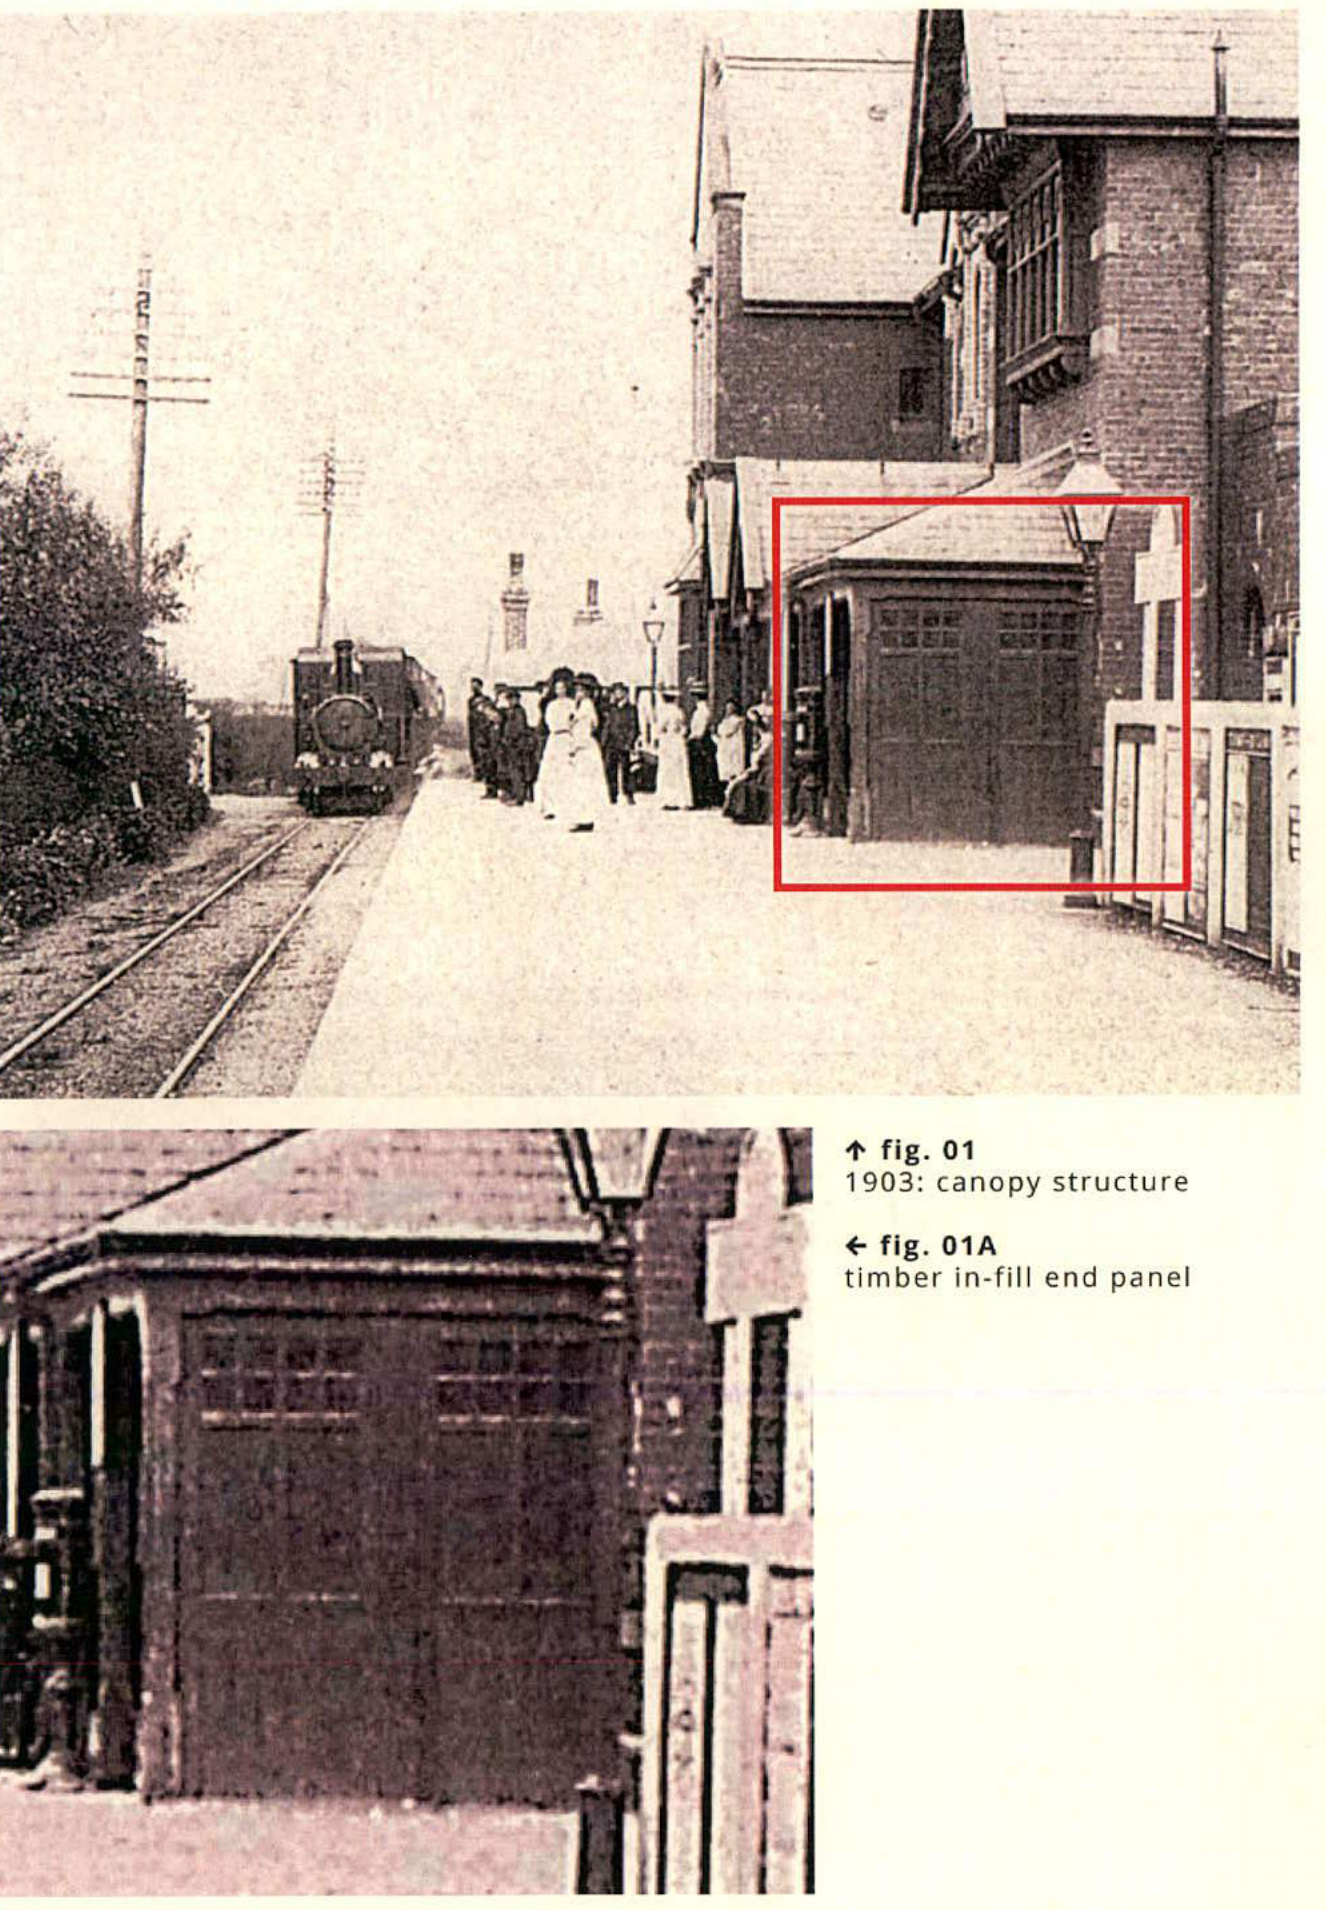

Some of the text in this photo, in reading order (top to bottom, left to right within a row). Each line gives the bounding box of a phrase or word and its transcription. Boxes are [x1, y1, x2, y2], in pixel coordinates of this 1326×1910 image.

[881, 1139, 974, 1166] fig. 01
[846, 1172, 1189, 1198] 1903: canopy structure
[880, 1235, 997, 1262] fig. 01A
[845, 1266, 1190, 1293] timber in-fill end panel
